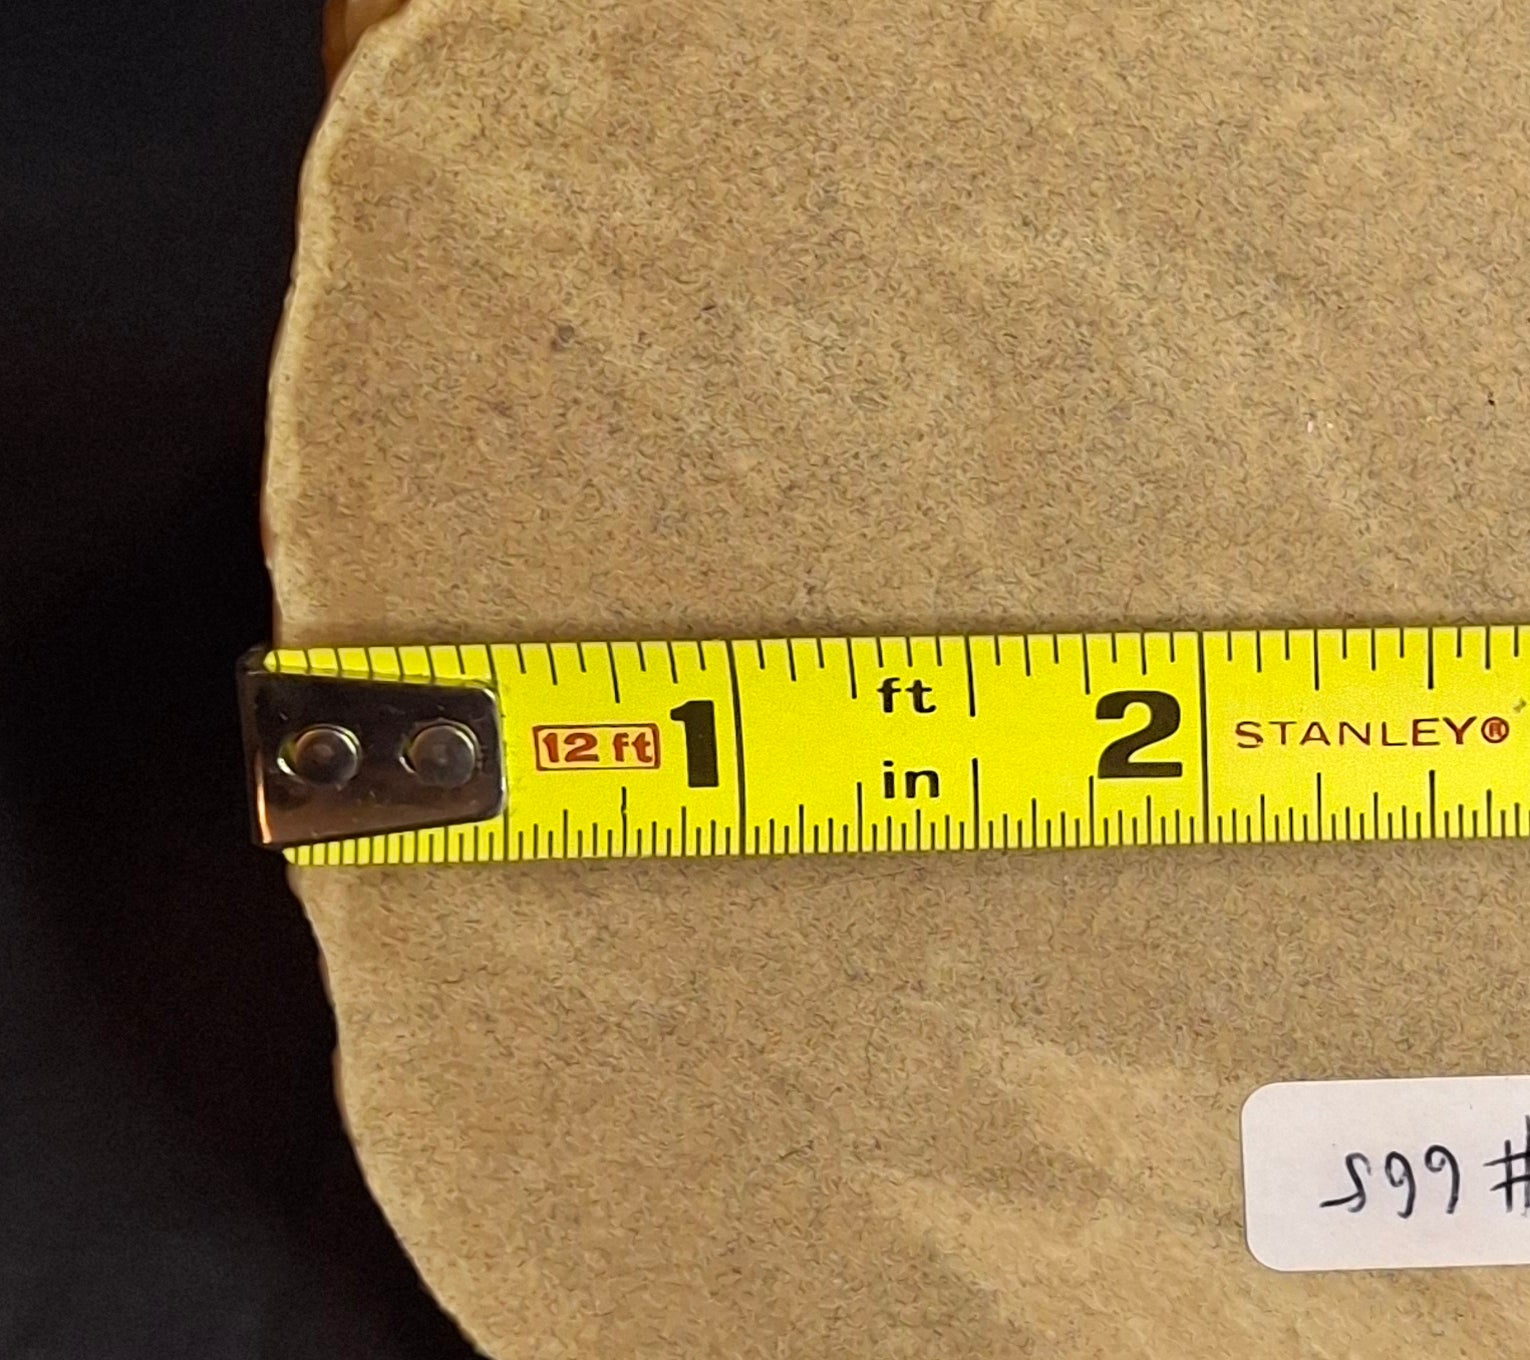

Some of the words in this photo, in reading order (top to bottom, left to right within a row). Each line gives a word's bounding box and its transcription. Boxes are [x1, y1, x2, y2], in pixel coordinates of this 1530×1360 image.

[877, 678, 937, 714] ft
[542, 732, 600, 763] 12
[613, 731, 652, 763] ft
[670, 700, 719, 788] 1
[1095, 689, 1183, 780] 2
[882, 761, 940, 799] in
